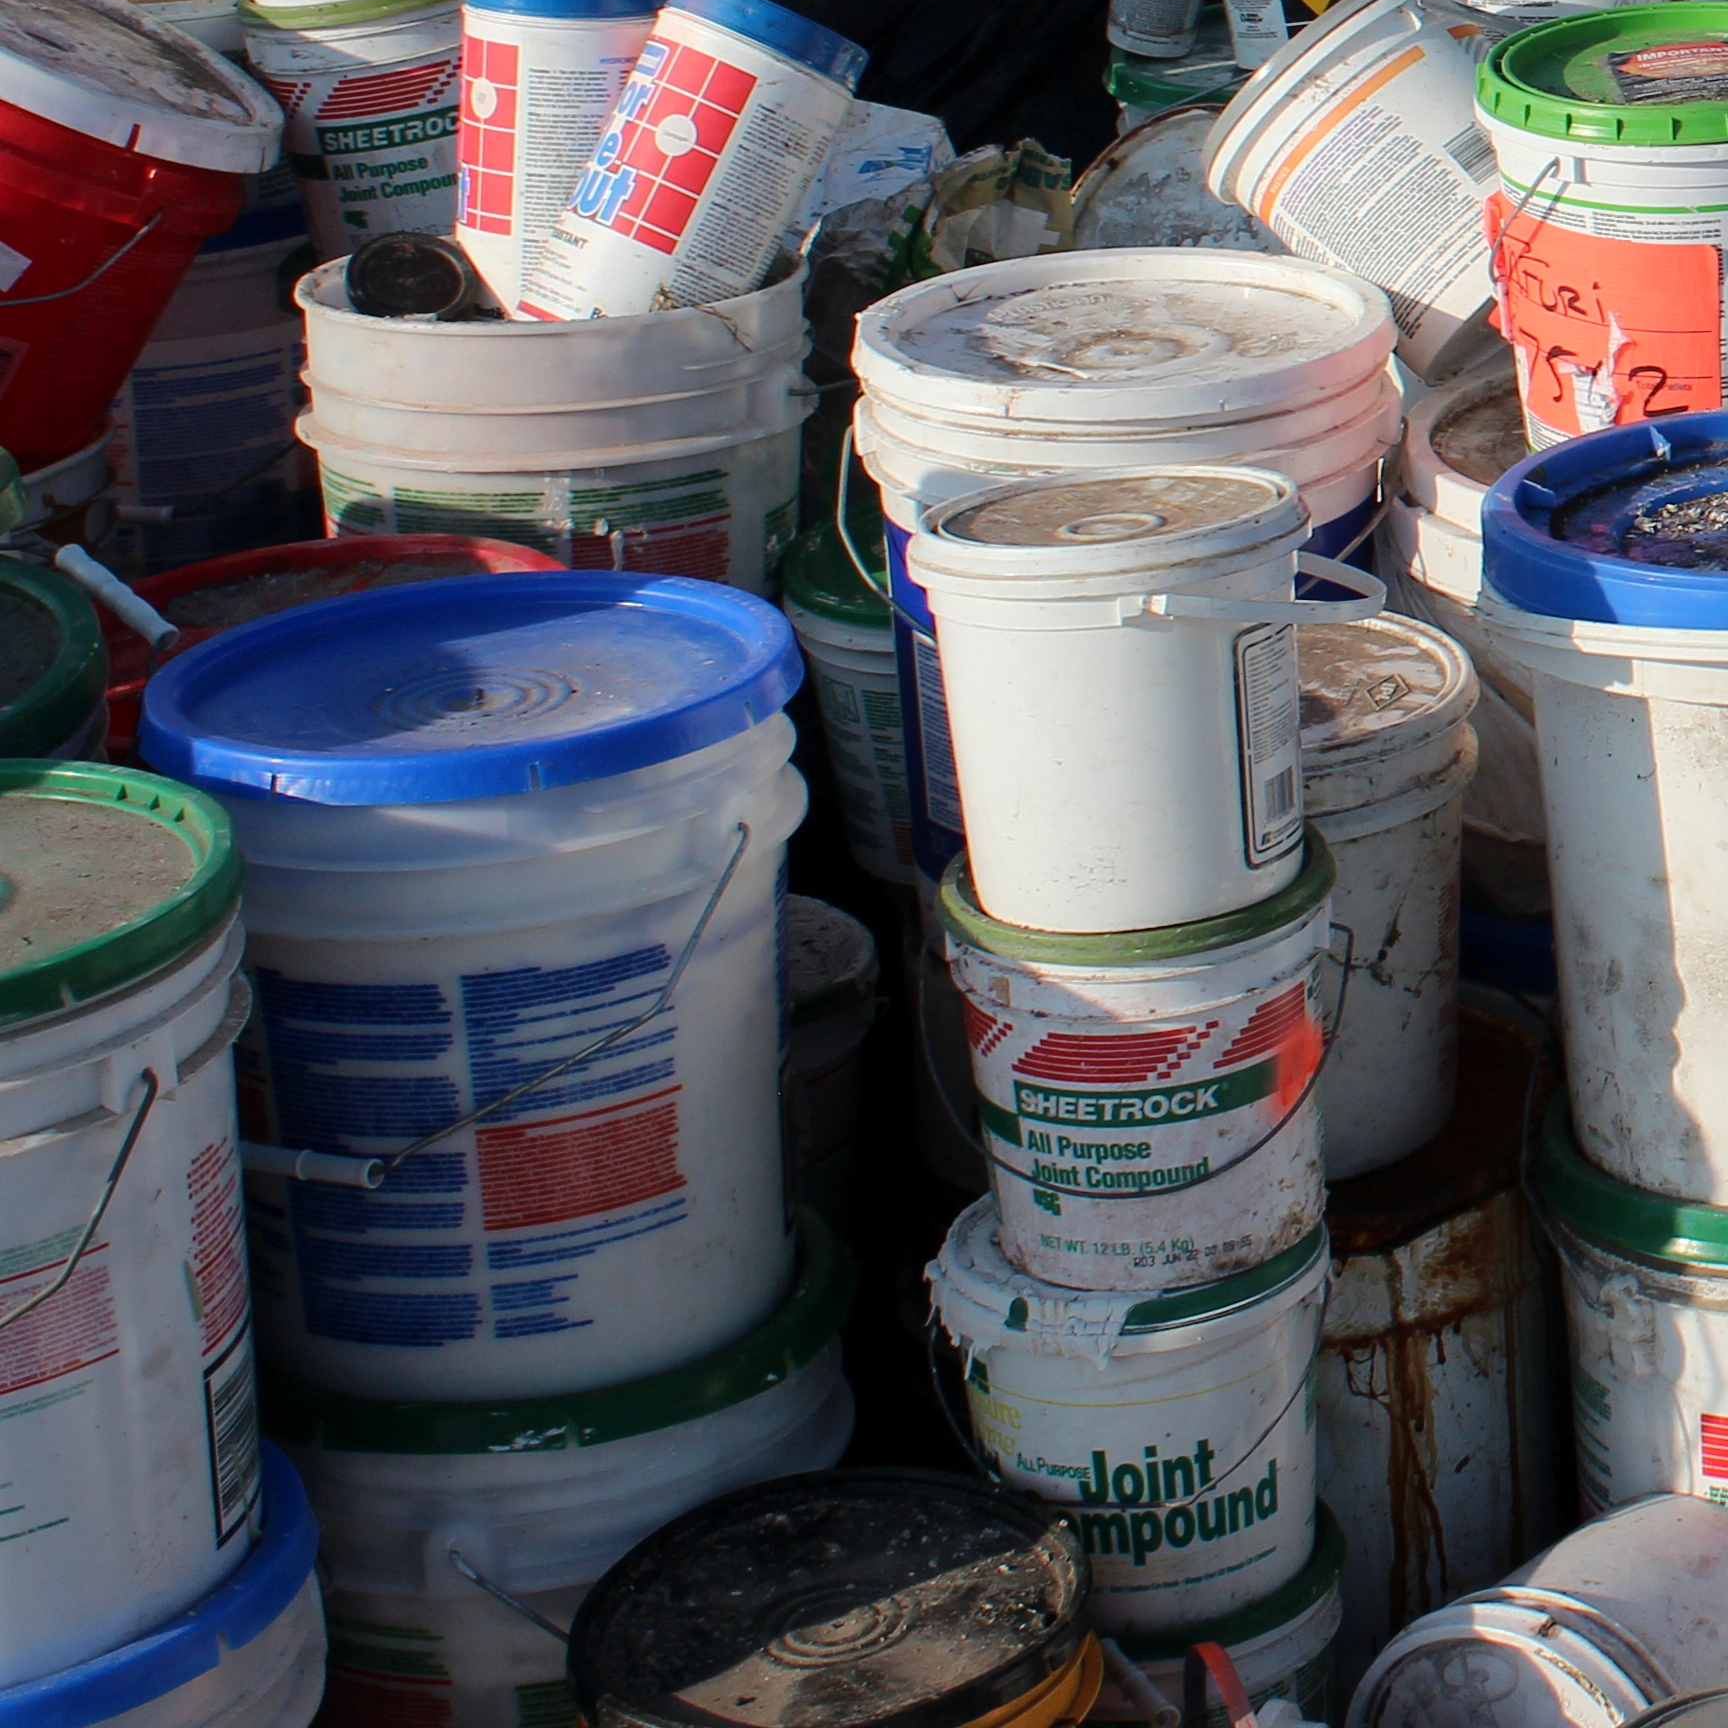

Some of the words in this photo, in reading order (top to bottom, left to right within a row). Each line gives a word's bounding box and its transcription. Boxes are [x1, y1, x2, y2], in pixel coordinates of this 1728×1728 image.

[333, 162, 355, 181] All
[359, 156, 429, 181] Purpose
[339, 182, 378, 202] Joint
[1019, 1084, 1220, 1121] SHEETROCK
[1027, 1130, 1051, 1154] All
[1057, 1135, 1152, 1164] Purpose
[1031, 1158, 1081, 1186] Joint
[1086, 1156, 1209, 1192] Compound
[1040, 1233, 1061, 1249] NET
[1093, 1242, 1107, 1255] 12
[1036, 1456, 1091, 1481] PURPOSE
[1078, 1438, 1218, 1506] Joint
